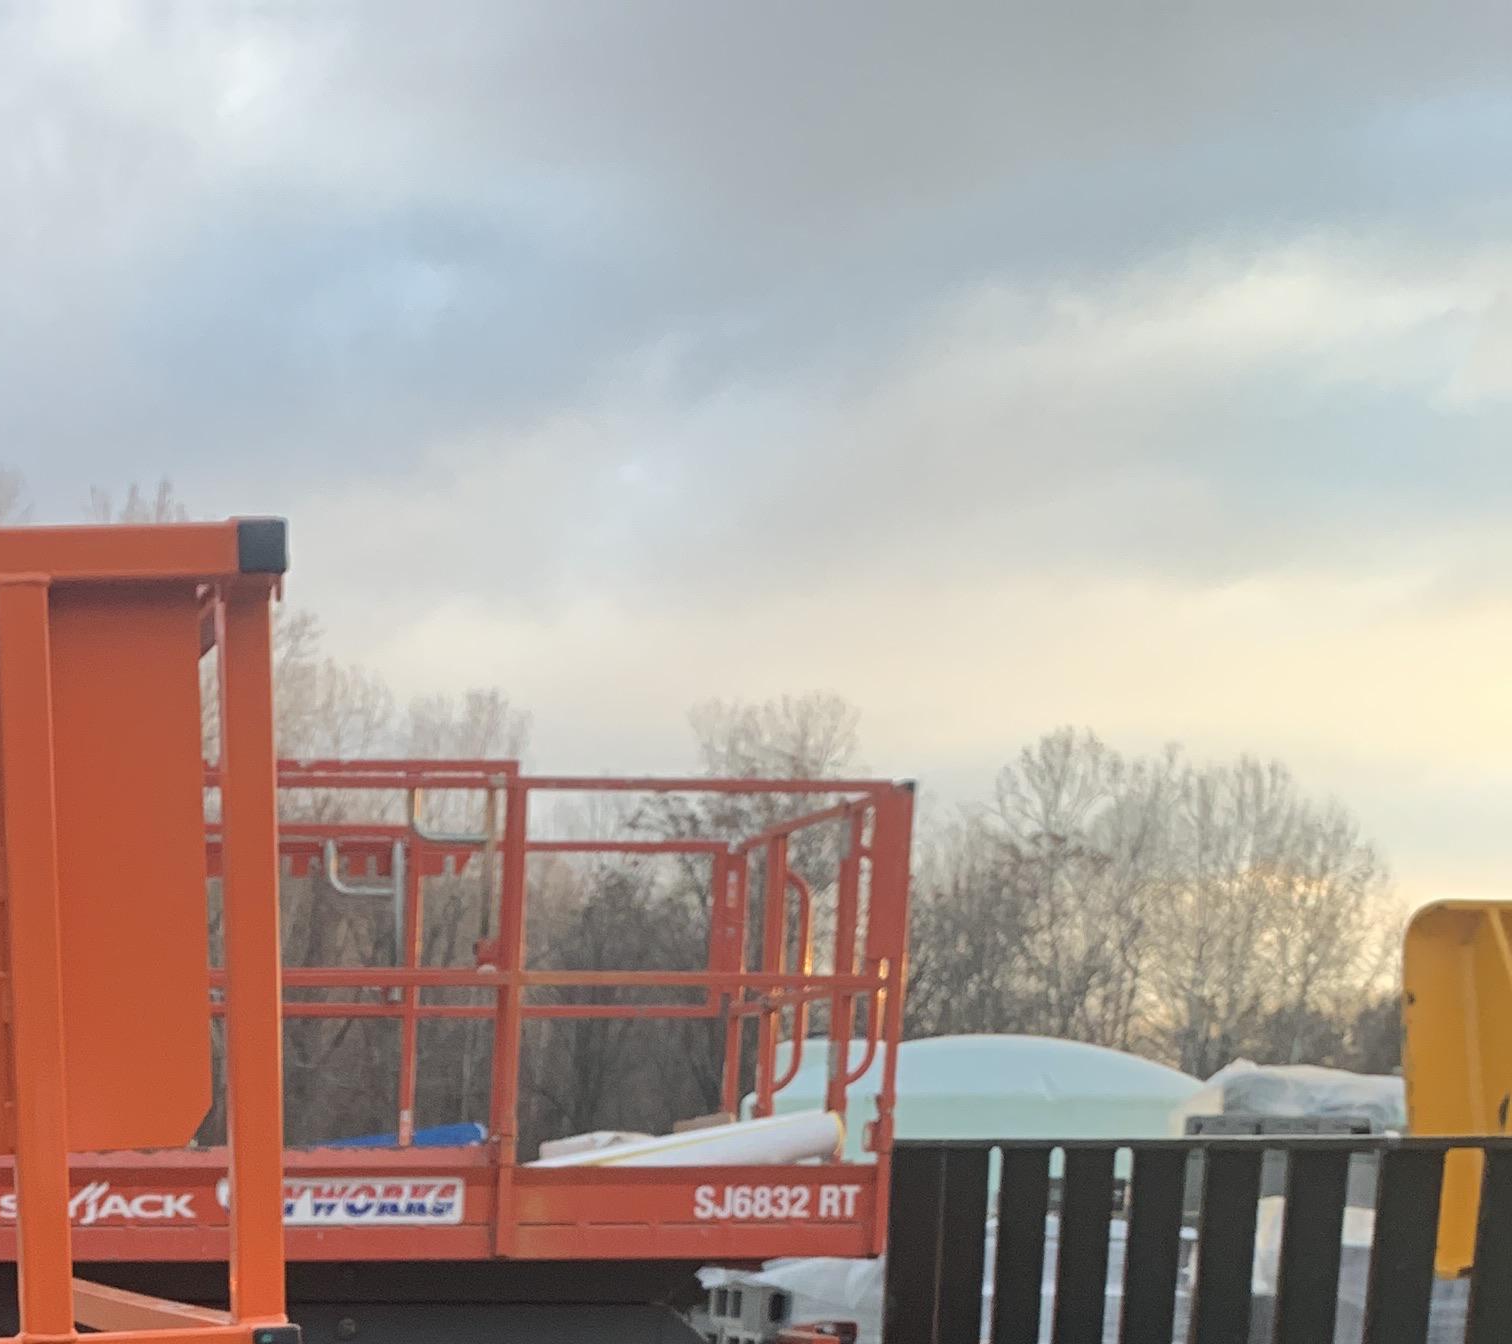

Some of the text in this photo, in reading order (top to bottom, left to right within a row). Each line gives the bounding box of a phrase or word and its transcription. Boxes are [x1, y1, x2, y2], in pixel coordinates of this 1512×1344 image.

[283, 1183, 457, 1218] YWORKS
[694, 1184, 861, 1219] SJ6832 RT
